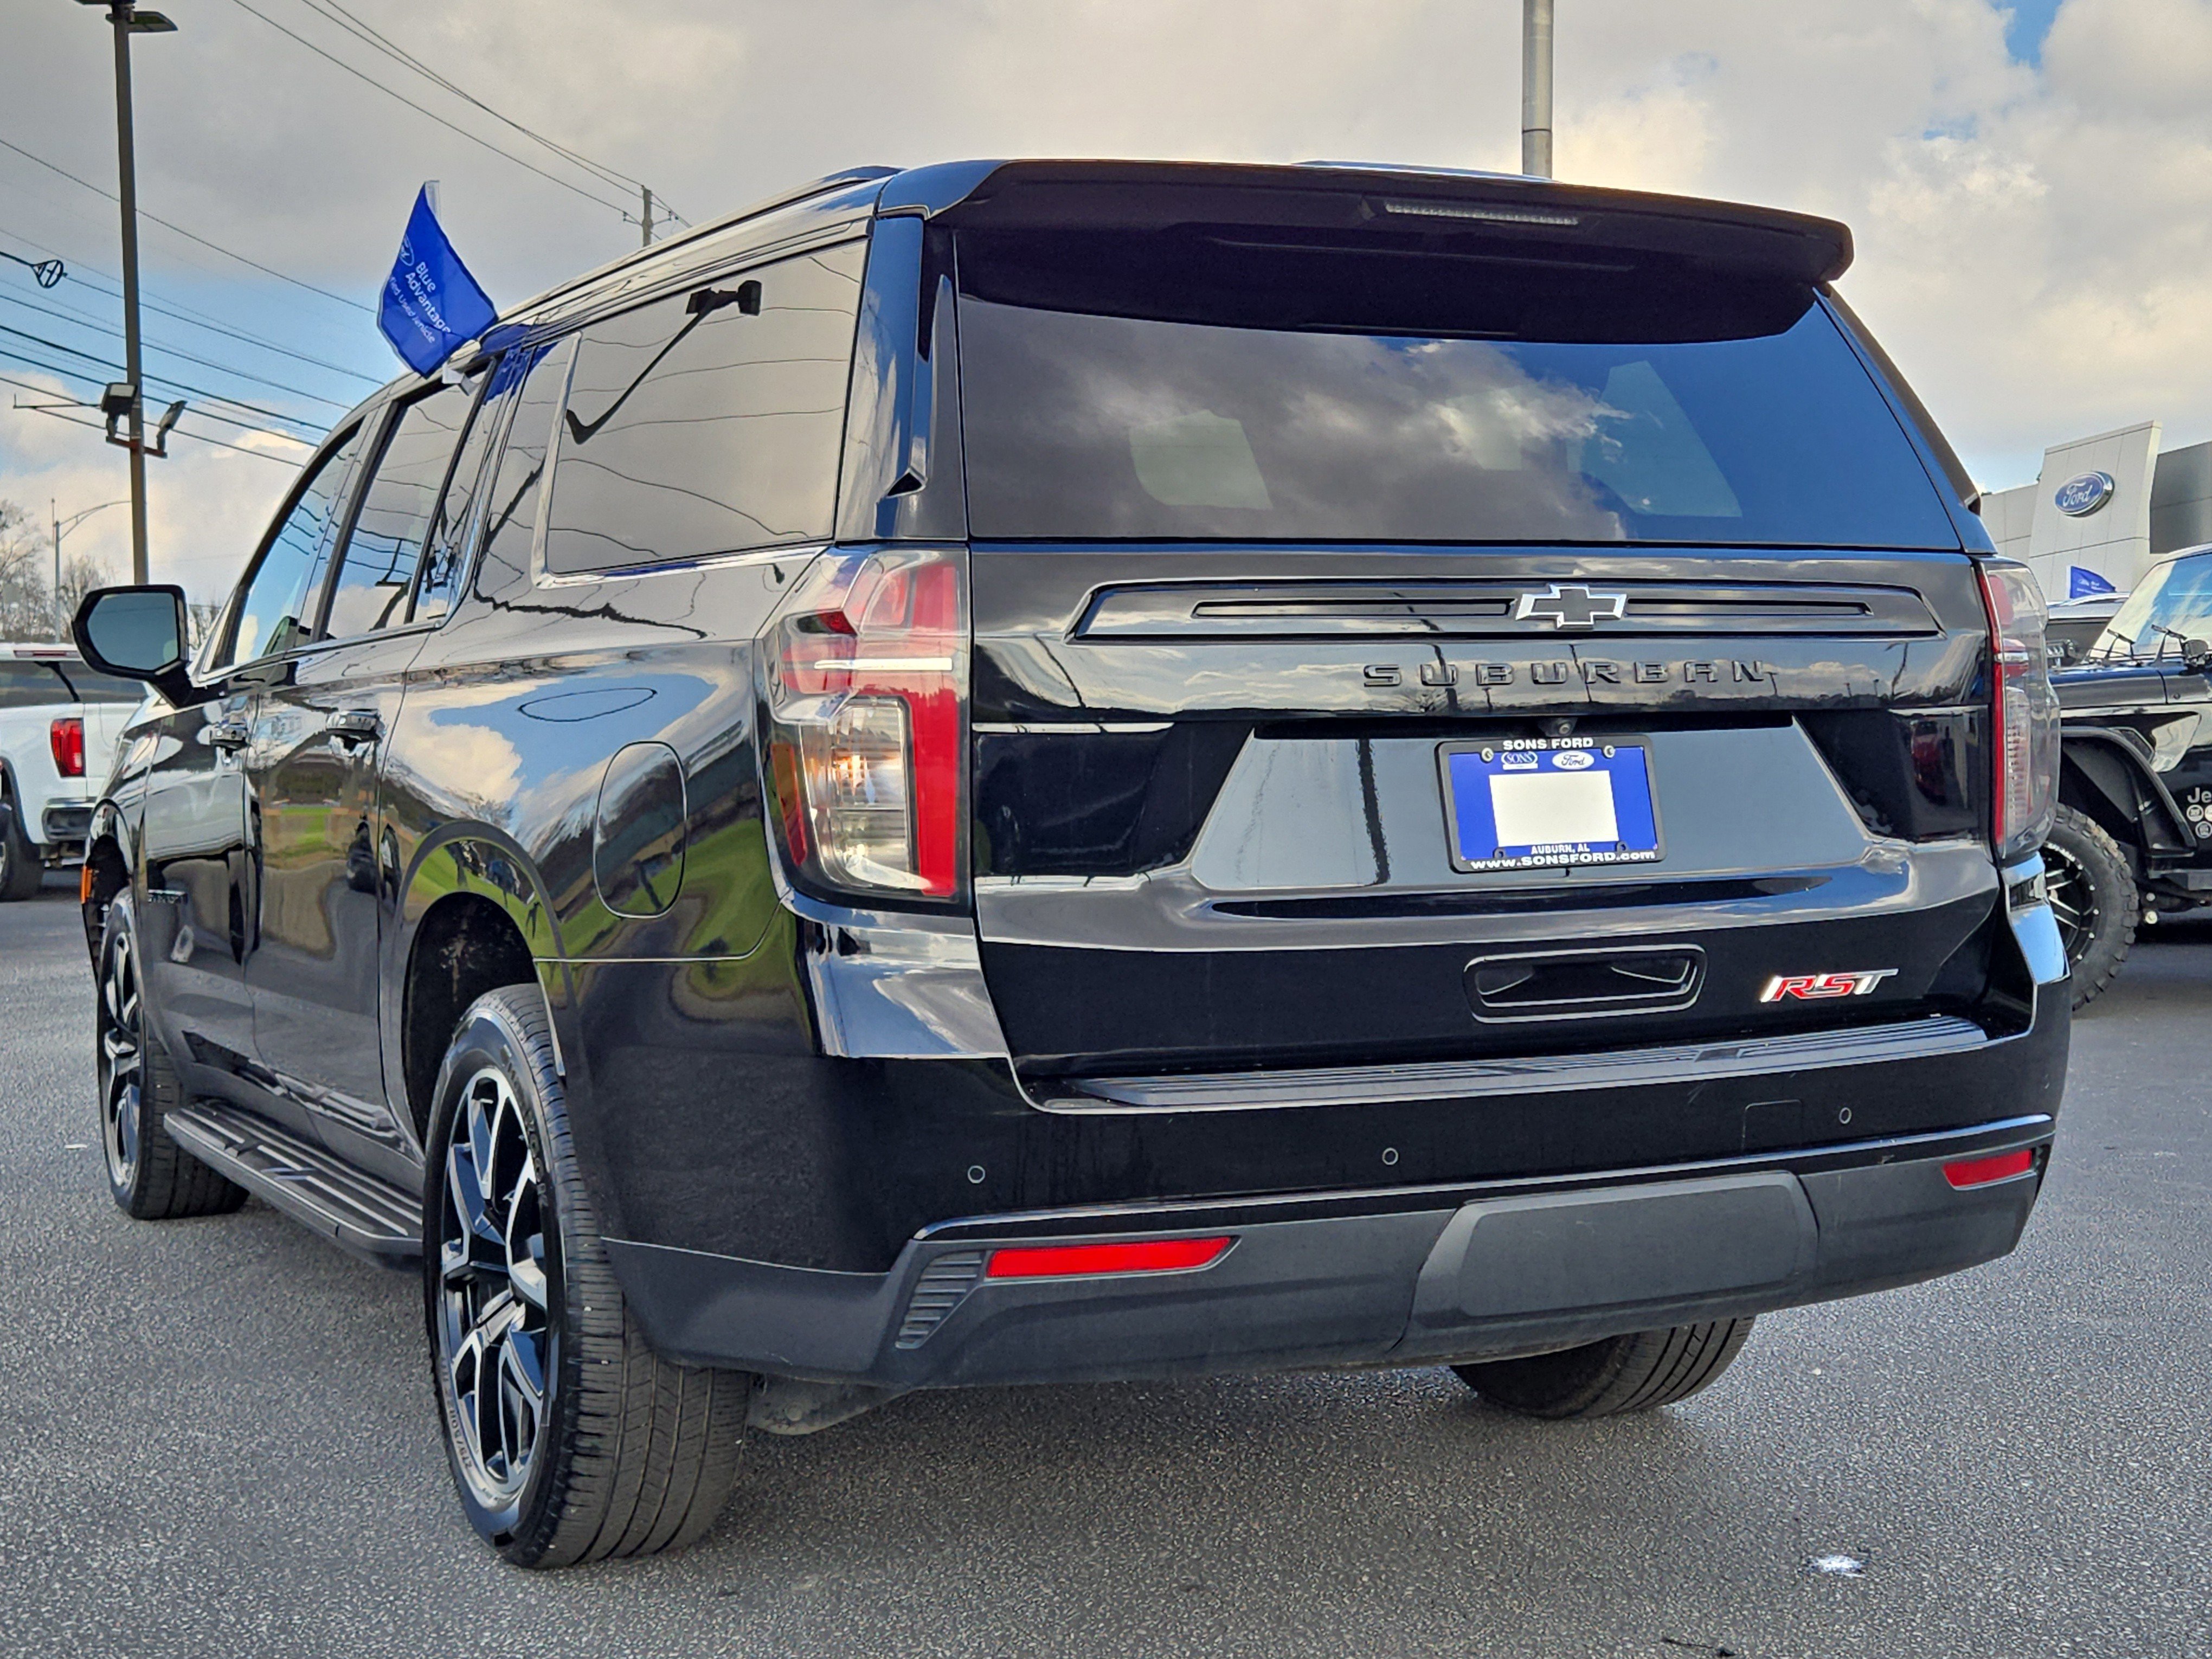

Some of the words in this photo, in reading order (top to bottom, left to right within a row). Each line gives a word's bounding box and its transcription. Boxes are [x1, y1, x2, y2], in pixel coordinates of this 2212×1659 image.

[416, 261, 436, 293] Blue
[406, 272, 451, 333] Advantage
[2062, 481, 2093, 507] Ford
[1364, 660, 1766, 687] SUBURBAN
[1503, 739, 1547, 750] SONS
[1552, 737, 1593, 749] FORD
[1561, 754, 1585, 766] Ford
[1471, 851, 1655, 870] www.SONSFORD.com
[1578, 843, 1590, 852] AL
[1761, 968, 1899, 1002] RST
